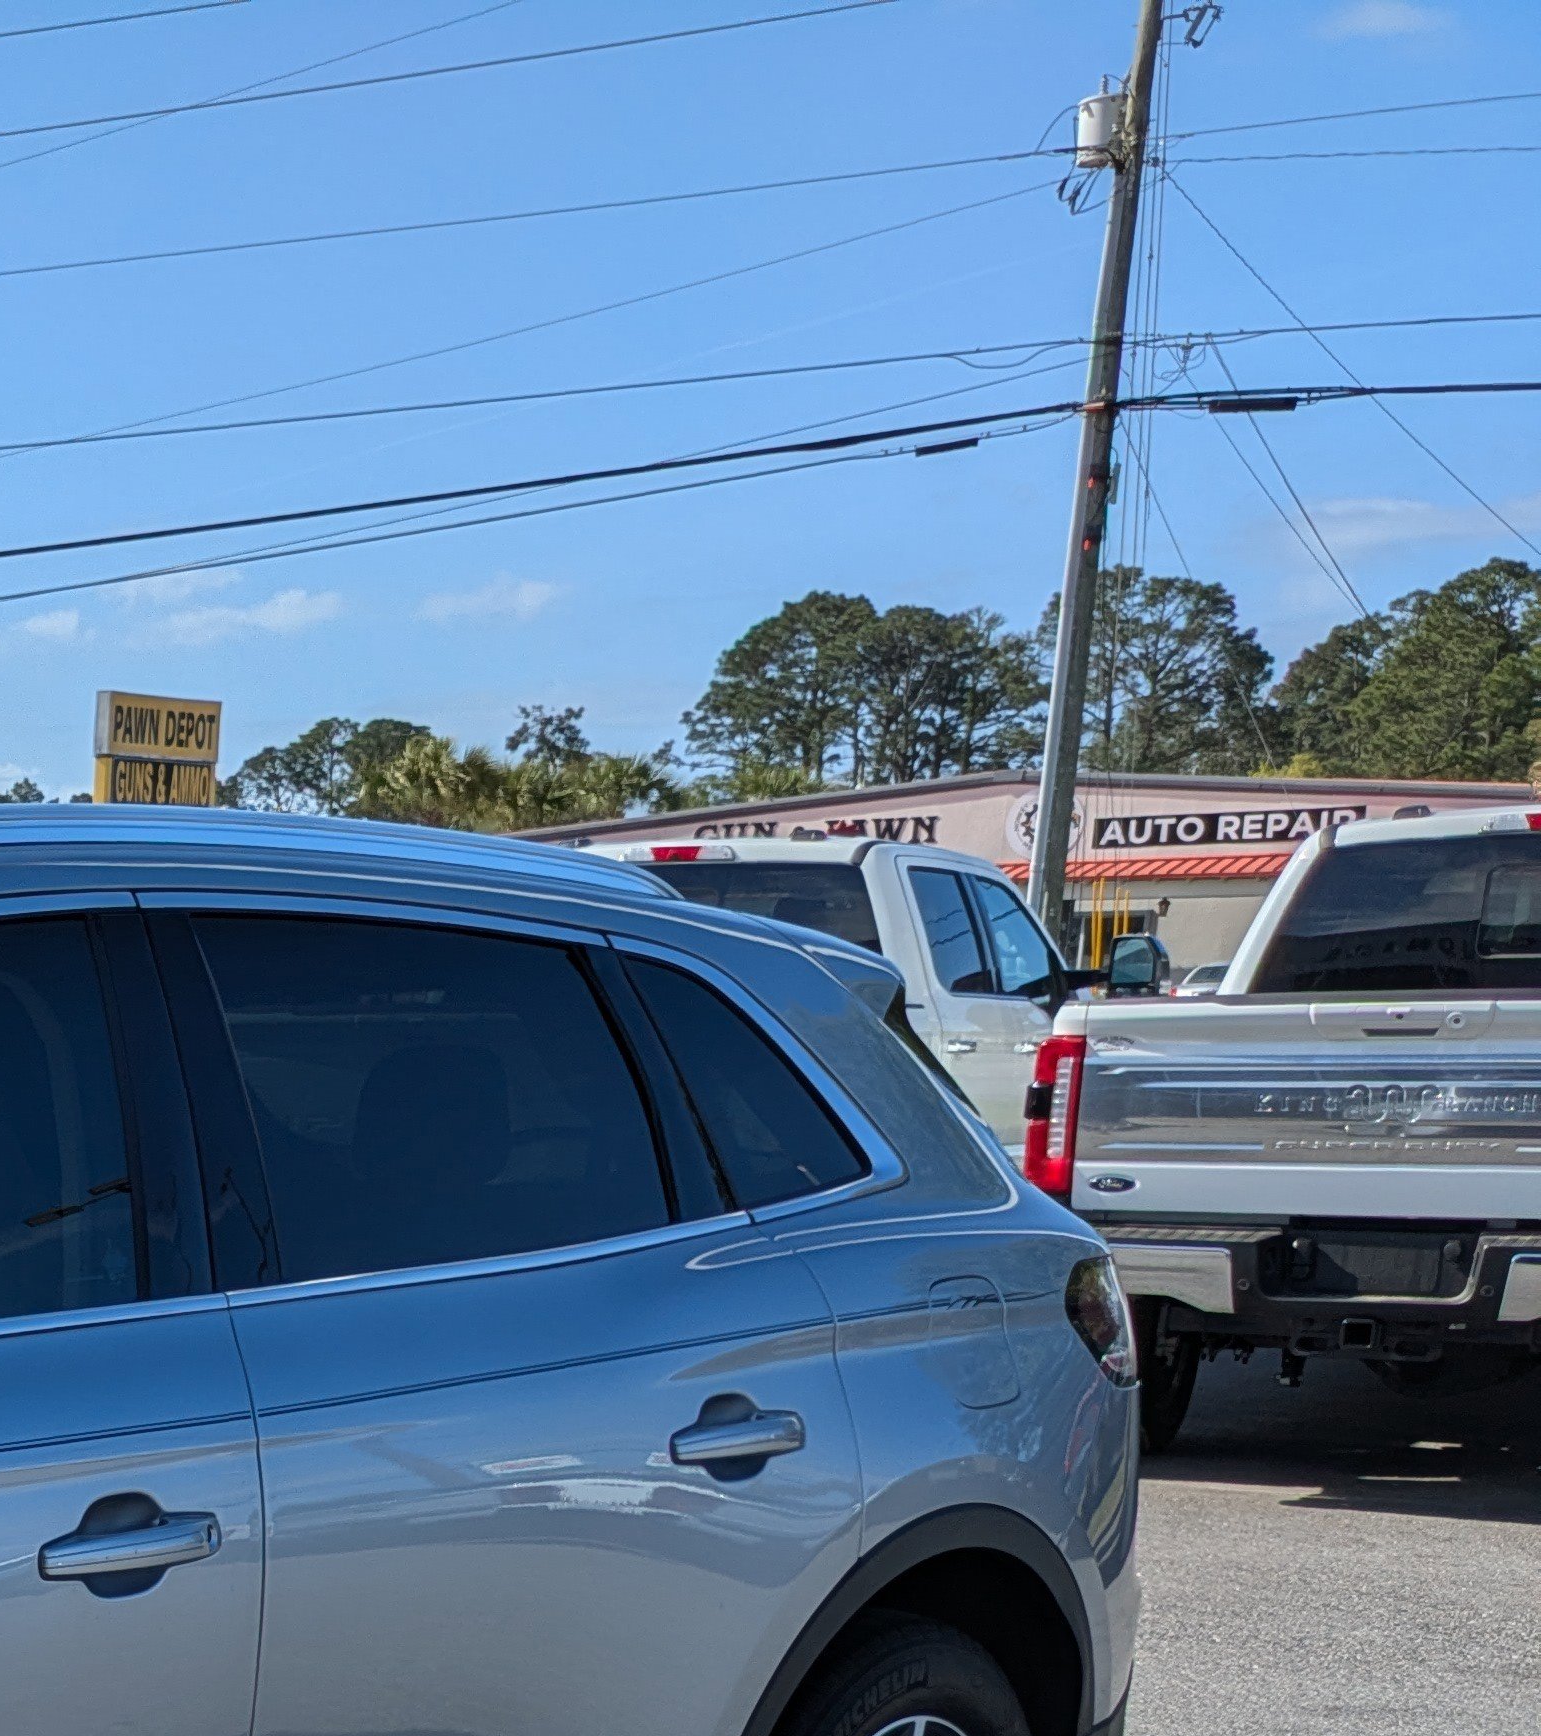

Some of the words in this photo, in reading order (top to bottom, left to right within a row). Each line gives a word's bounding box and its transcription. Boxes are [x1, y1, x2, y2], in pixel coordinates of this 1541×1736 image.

[113, 705, 160, 746] PAWN
[164, 710, 216, 750] DEPOT
[116, 761, 153, 802] GUNS
[156, 763, 166, 803] &
[169, 764, 209, 804] AMMO
[1099, 816, 1206, 846] AUTO
